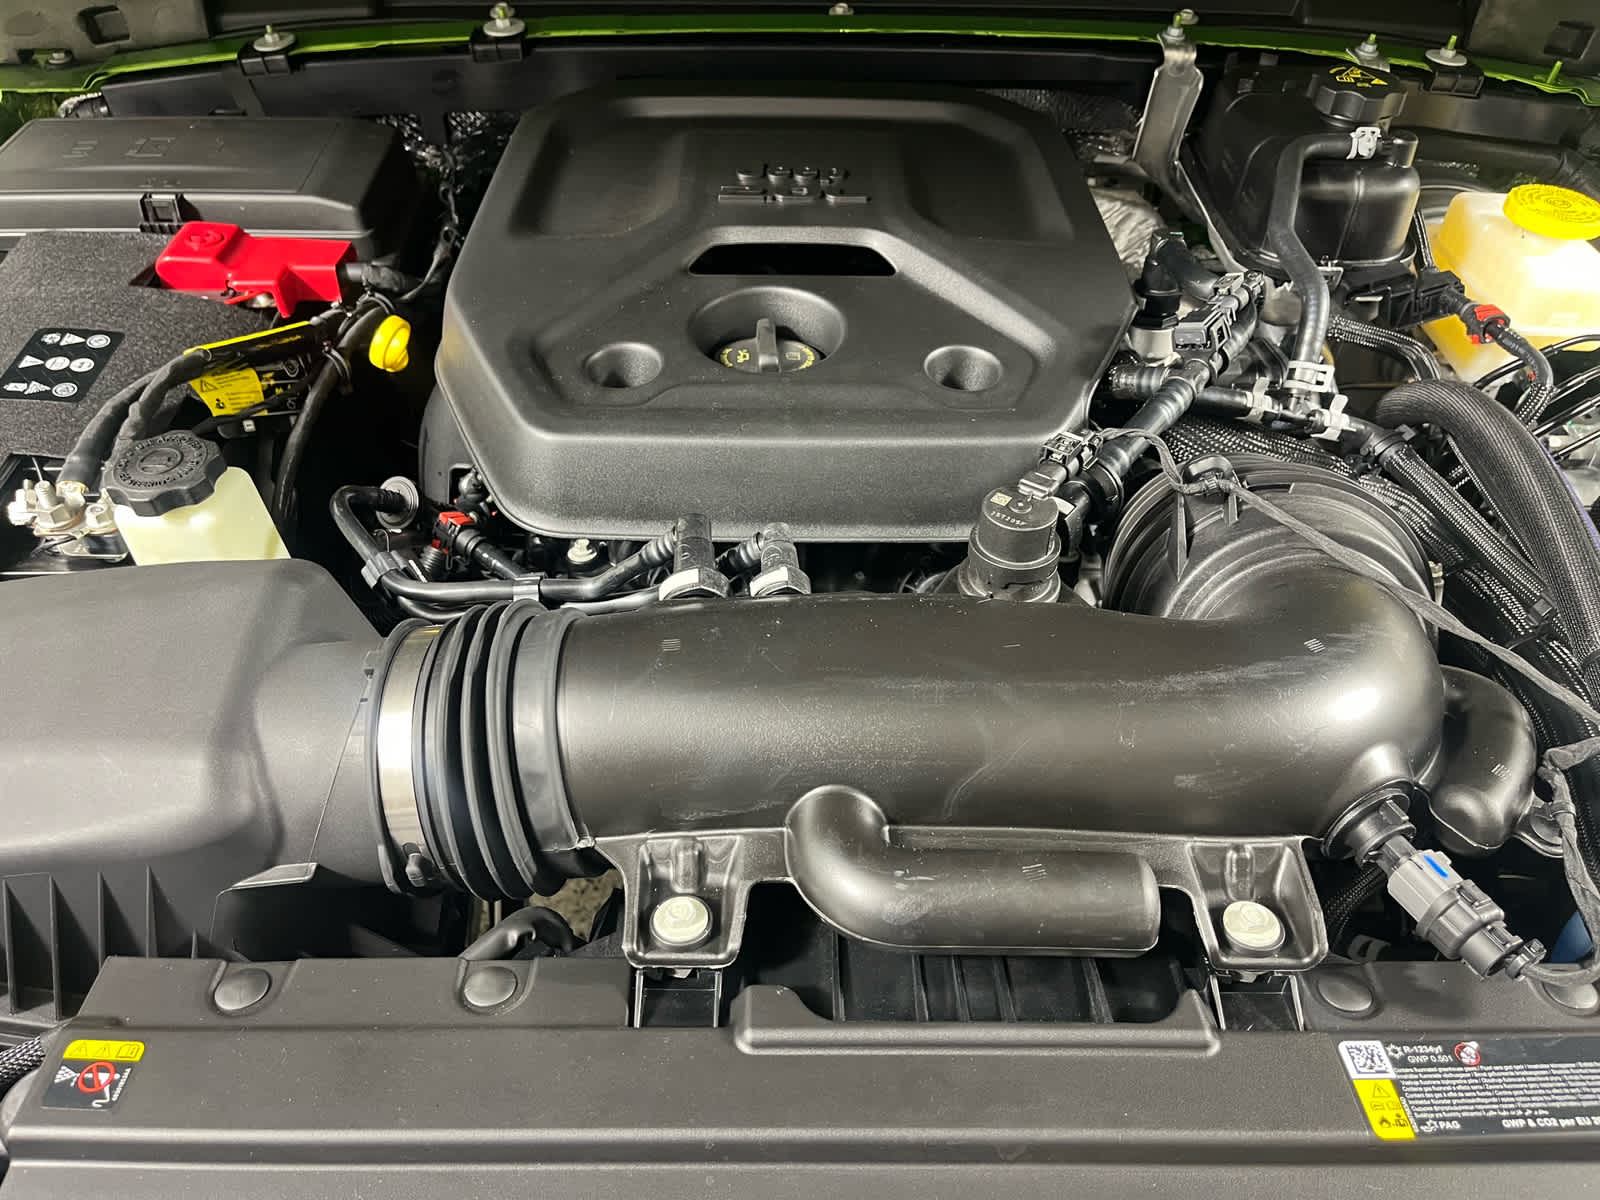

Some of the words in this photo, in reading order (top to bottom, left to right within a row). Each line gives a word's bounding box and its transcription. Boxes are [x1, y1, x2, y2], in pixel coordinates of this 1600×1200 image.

[1407, 1055, 1429, 1063] GWP
[1438, 1120, 1461, 1129] PAG
[1502, 1118, 1526, 1128] GWP
[1536, 1117, 1559, 1127] CO2
[1575, 1116, 1592, 1126] EU
